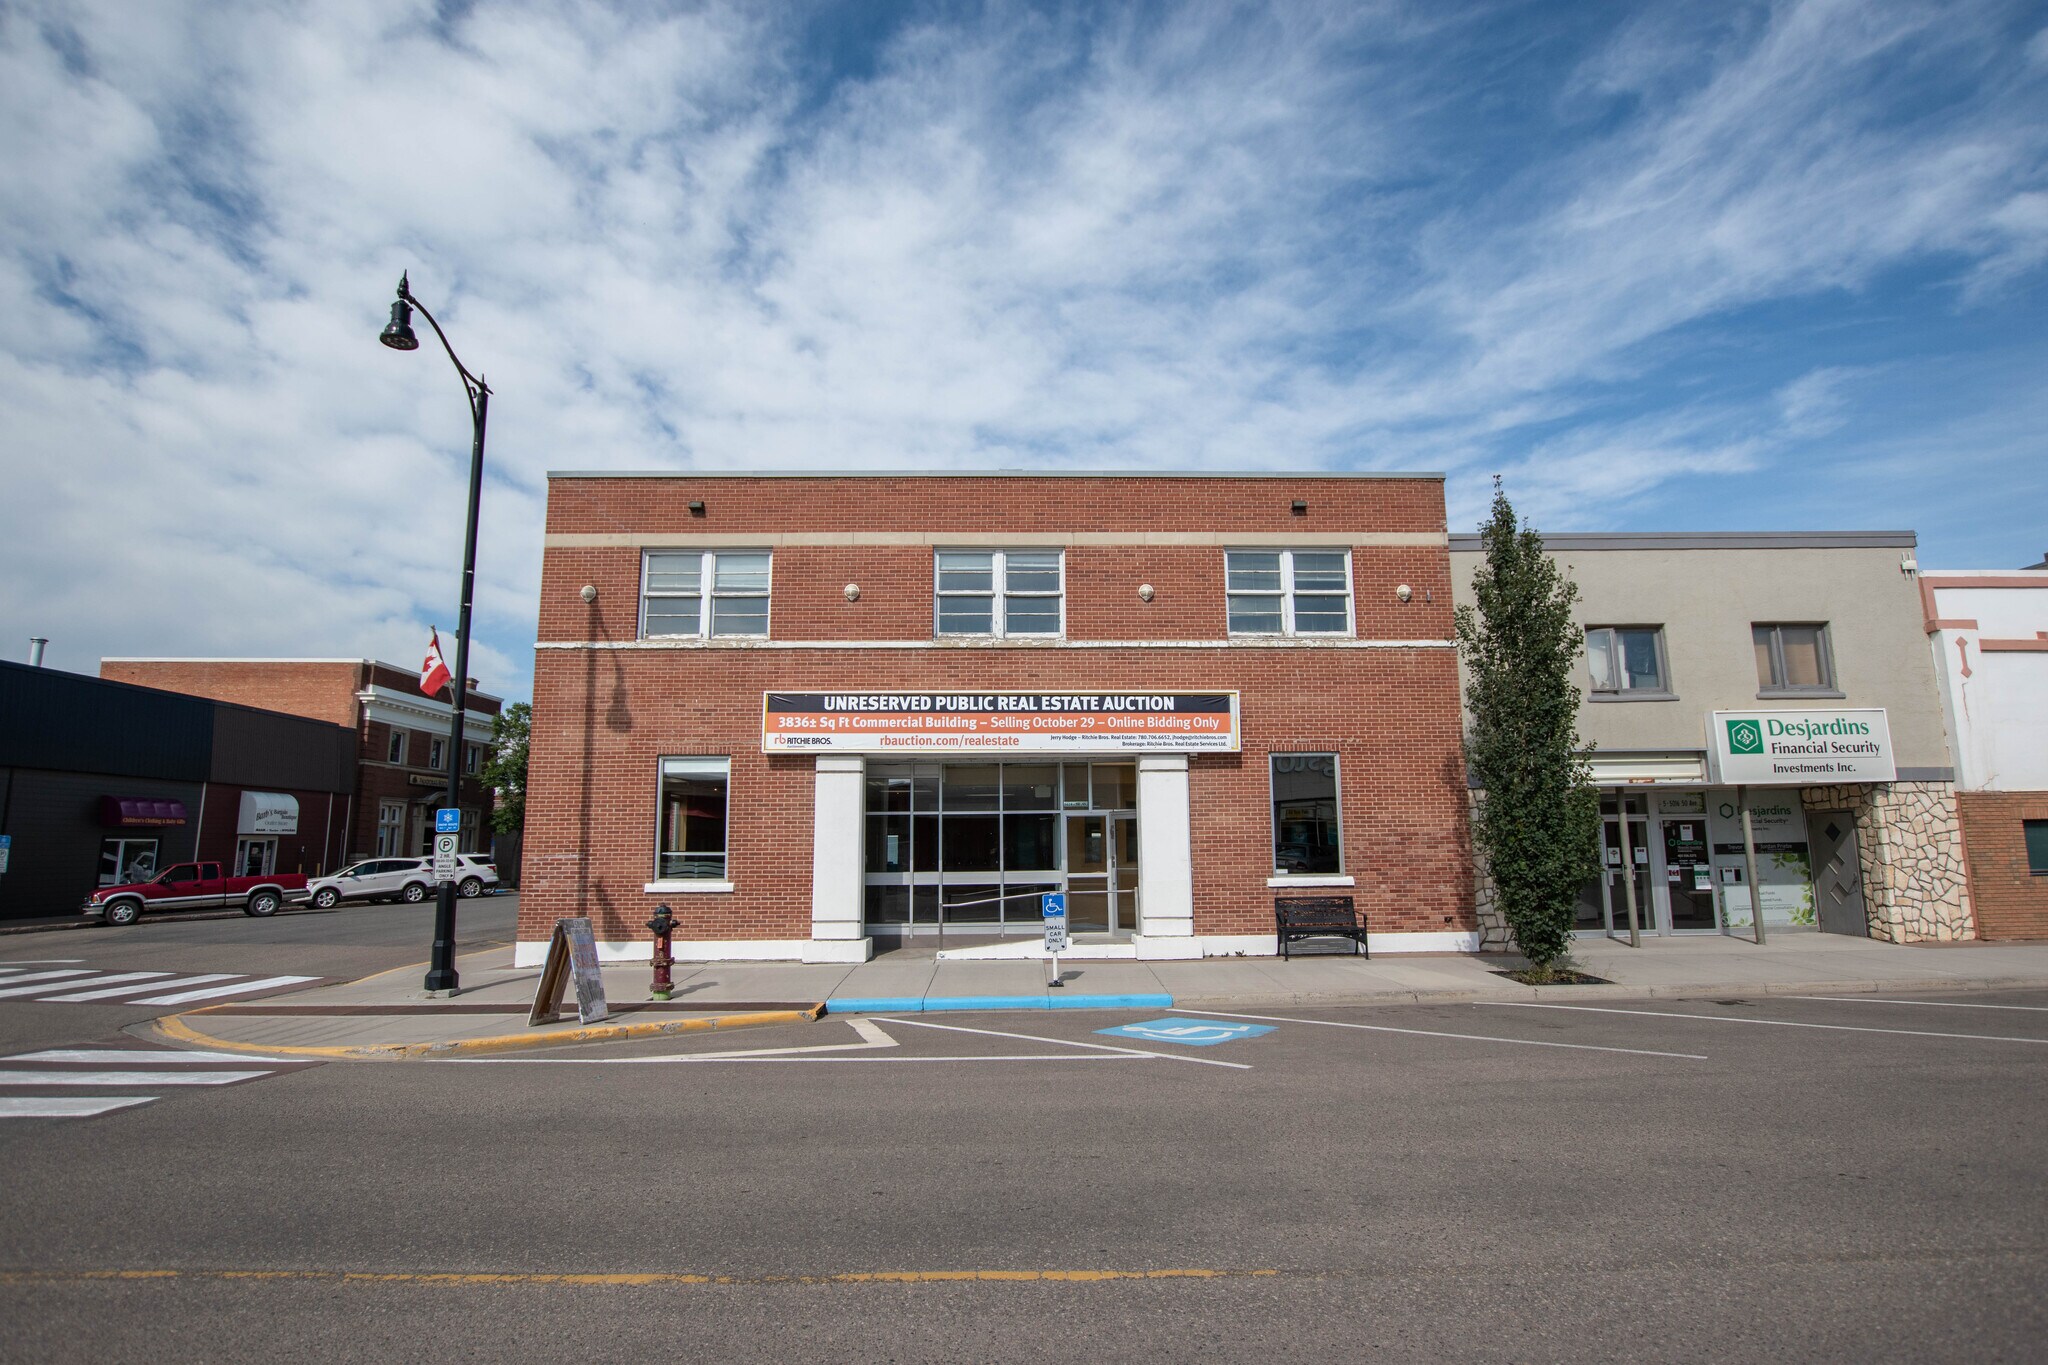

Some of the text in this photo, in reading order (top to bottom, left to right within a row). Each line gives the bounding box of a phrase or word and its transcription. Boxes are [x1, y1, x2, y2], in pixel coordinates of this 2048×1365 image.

[824, 696, 1174, 711] UNRESERVED PUBLIC REAL ESTATE AUCTION
[778, 717, 817, 728] 3836±
[820, 717, 835, 730] Sq
[839, 717, 850, 728] Ft
[852, 716, 923, 728] Commercial
[926, 716, 977, 730] Building
[991, 716, 1030, 730] Selling
[1033, 716, 1078, 728] October
[1080, 717, 1095, 728] 29
[1107, 716, 1145, 728] Online
[1147, 717, 1191, 730] Bidding
[1193, 716, 1219, 730] Only
[1767, 718, 1869, 741] Desjardins
[880, 735, 1020, 748] rbauction.com/realestate
[1771, 741, 1880, 756] Financial Security
[1773, 763, 1856, 773] Investments Inc.
[443, 840, 450, 849] P
